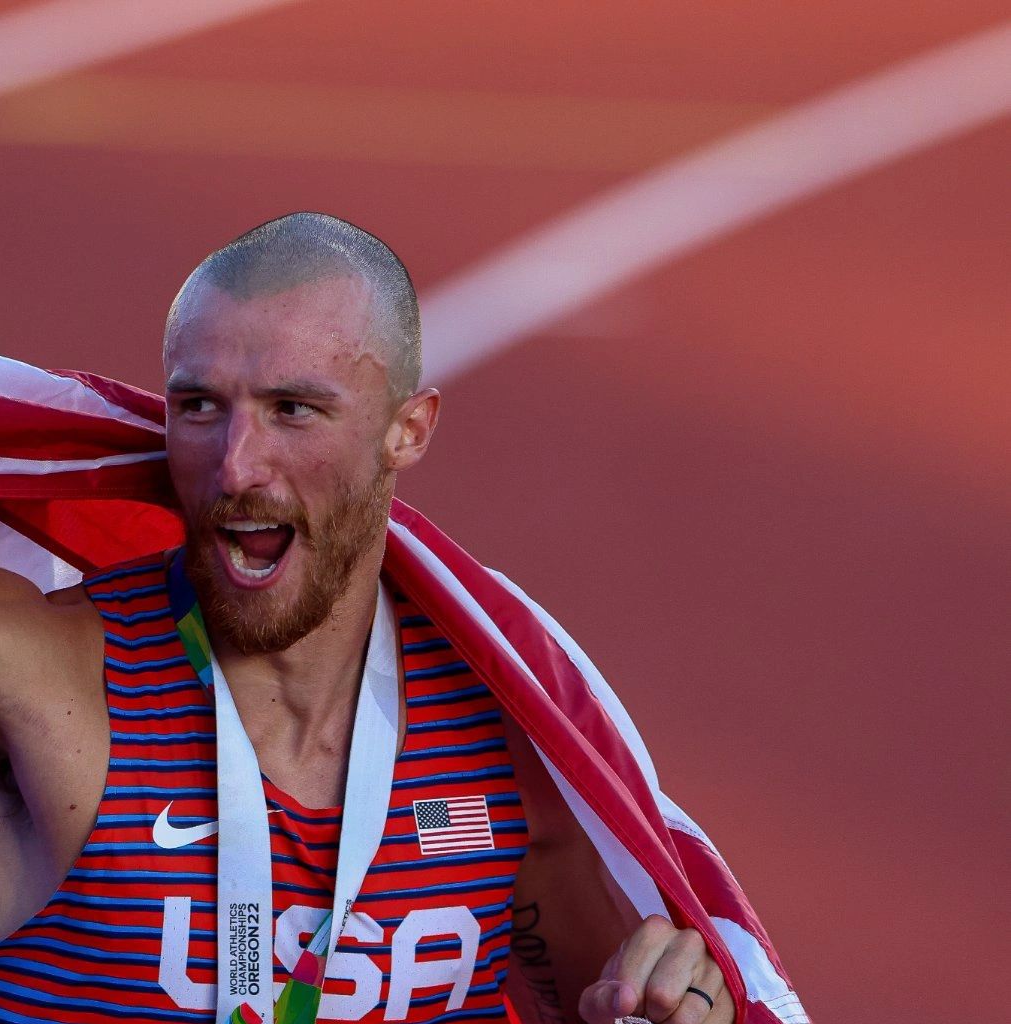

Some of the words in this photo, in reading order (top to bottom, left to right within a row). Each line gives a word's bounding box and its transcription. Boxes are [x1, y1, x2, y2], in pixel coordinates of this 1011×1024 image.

[230, 903, 238, 957] ATHLETICS
[238, 903, 247, 995] CHAMPIONSHIPS
[230, 960, 238, 995] WORLD
